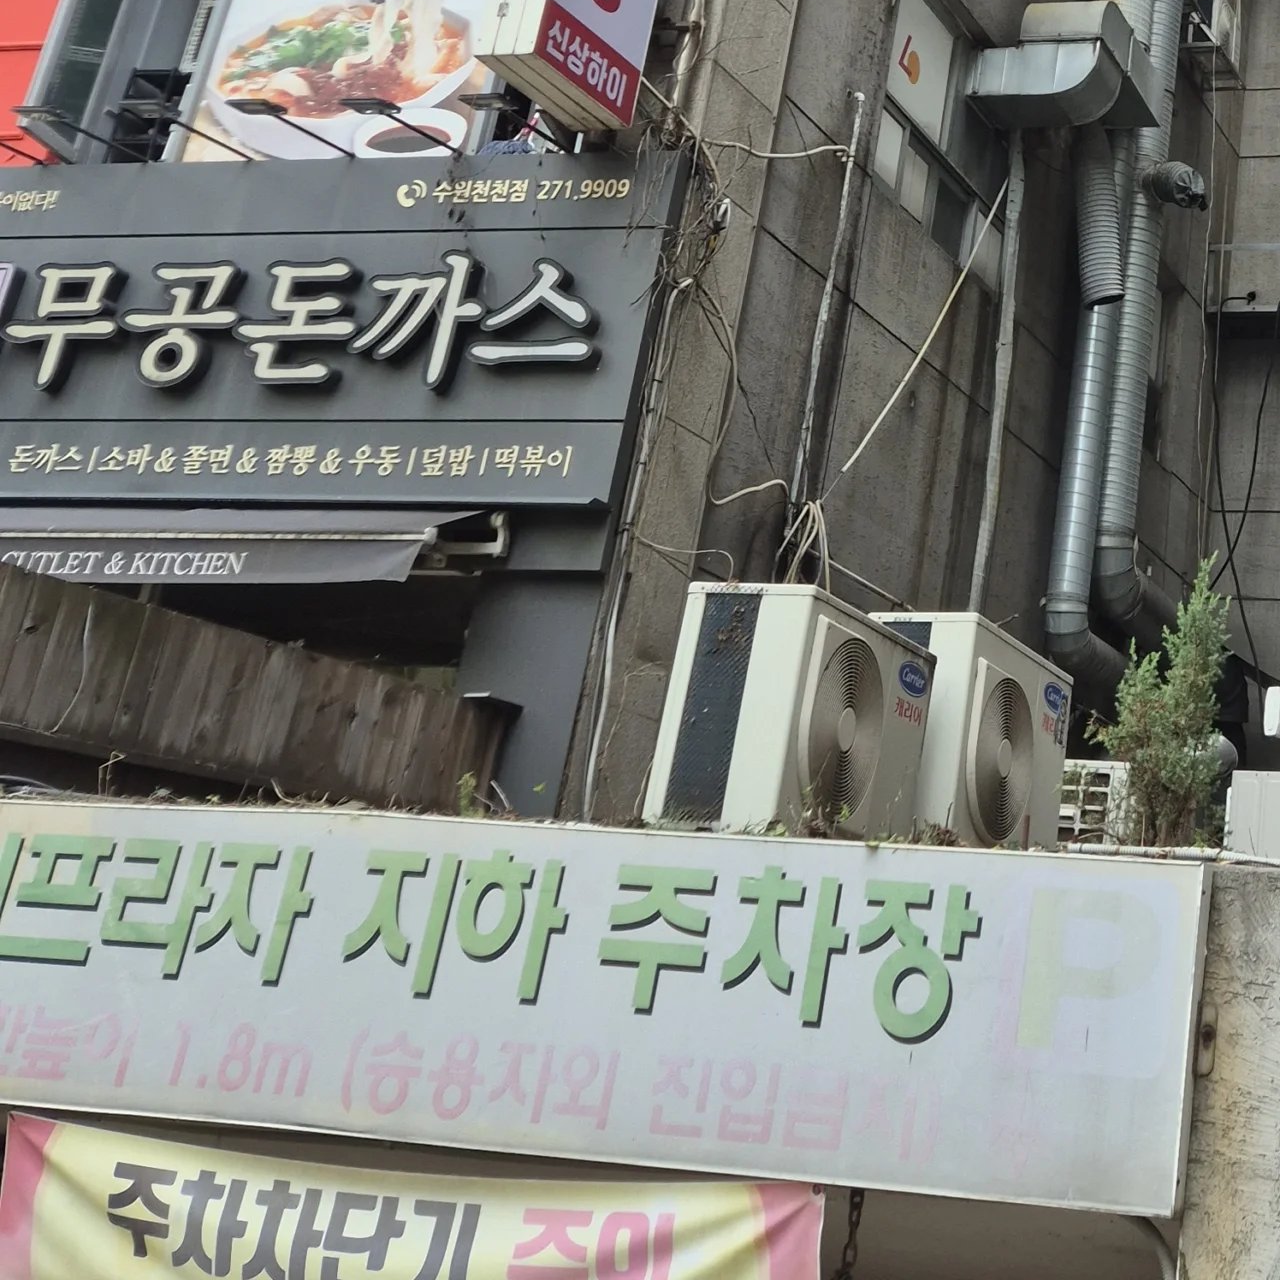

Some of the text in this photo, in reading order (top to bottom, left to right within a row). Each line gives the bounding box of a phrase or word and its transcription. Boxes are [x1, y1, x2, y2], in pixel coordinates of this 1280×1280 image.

[546, 19, 627, 108] 신상하이
[0, 190, 60, 211] 이없다!
[432, 179, 630, 203] 수원천천점 271.9909
[2, 250, 596, 393] 무공돈까스
[347, 445, 402, 477] 우동
[420, 445, 476, 477] 덮밥
[494, 445, 573, 478] 떡볶이
[104, 551, 127, 574] &
[128, 551, 249, 575] KITCHEN
[902, 667, 925, 689] Carrier
[342, 848, 569, 1006] 지하
[598, 863, 983, 1045] 주차장
[168, 1020, 314, 1096] 1.8m
[107, 1161, 482, 1280] 주차차단기
